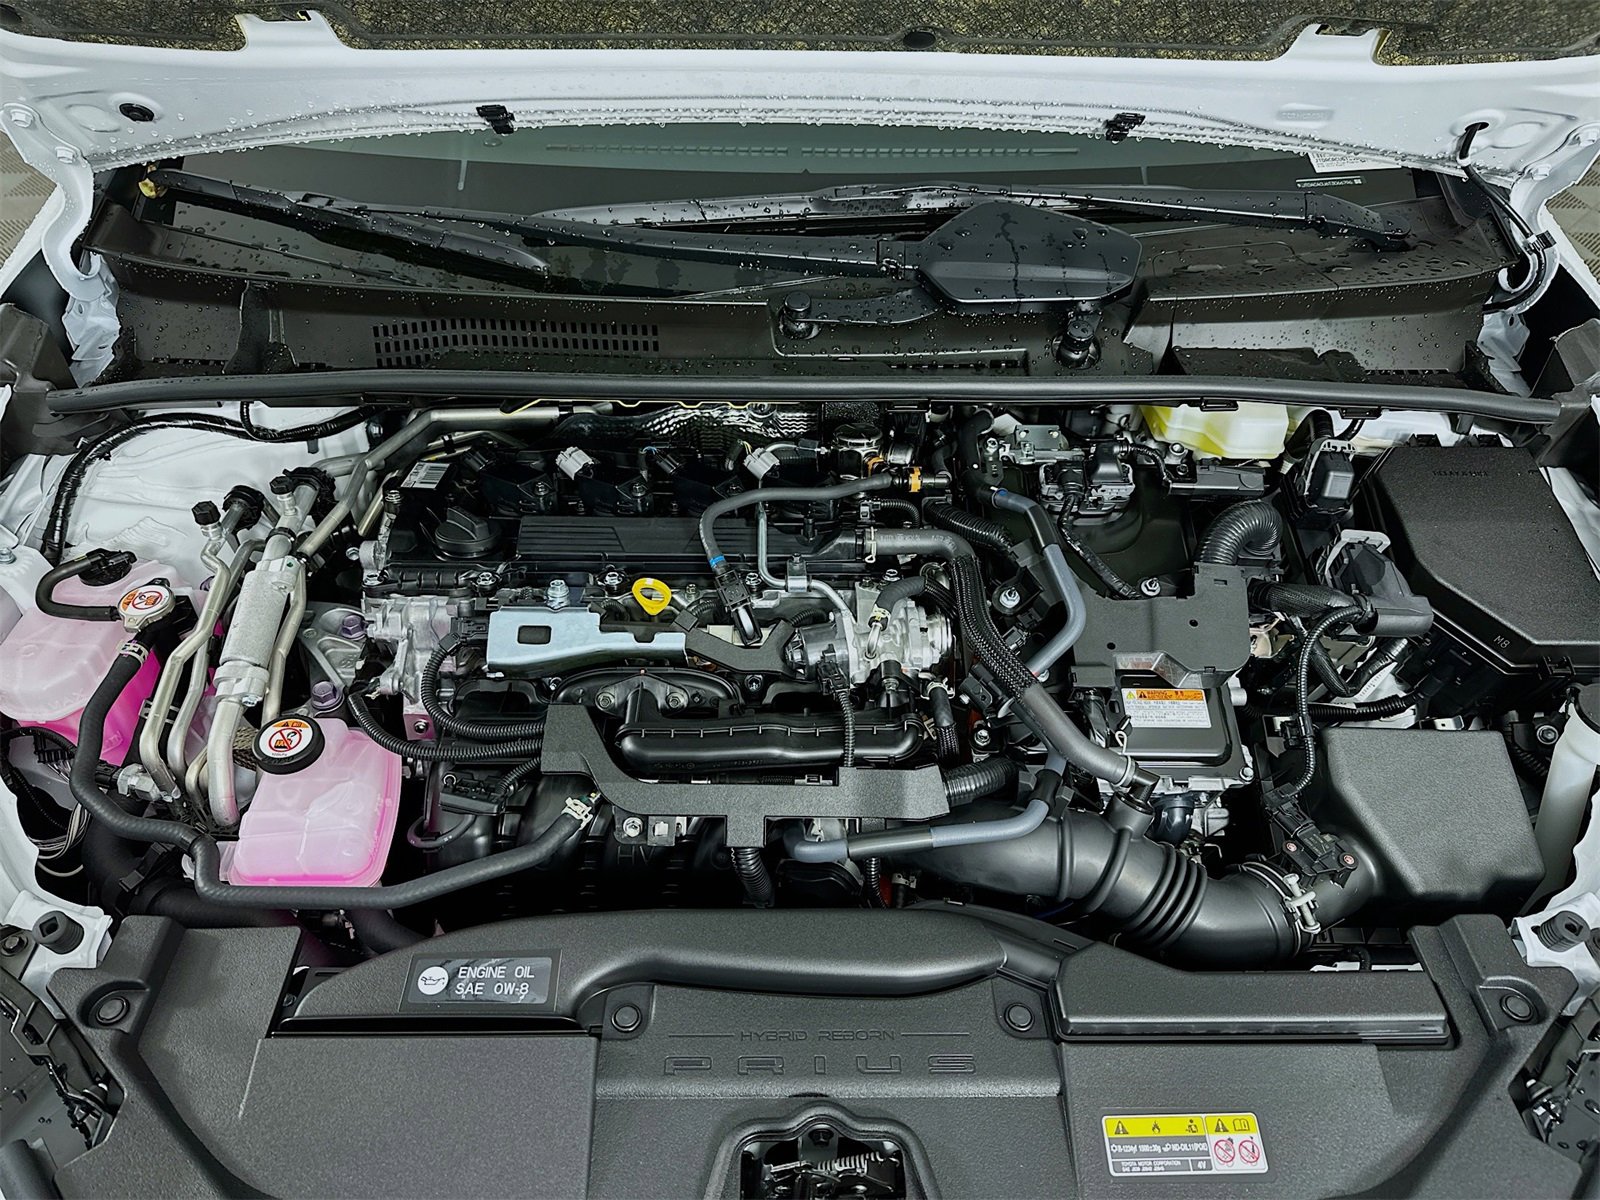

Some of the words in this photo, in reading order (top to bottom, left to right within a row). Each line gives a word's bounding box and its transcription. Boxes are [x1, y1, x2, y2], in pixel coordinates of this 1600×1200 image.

[1493, 635, 1511, 649] M8
[617, 845, 655, 865] HV
[458, 966, 507, 979] ENGINE
[514, 966, 535, 979] OIL
[455, 982, 485, 995] SAE
[493, 982, 529, 995] 0W-8
[740, 1030, 807, 1042] HYBRID
[818, 1029, 895, 1041] REBORN
[663, 1053, 977, 1076] PRIUS
